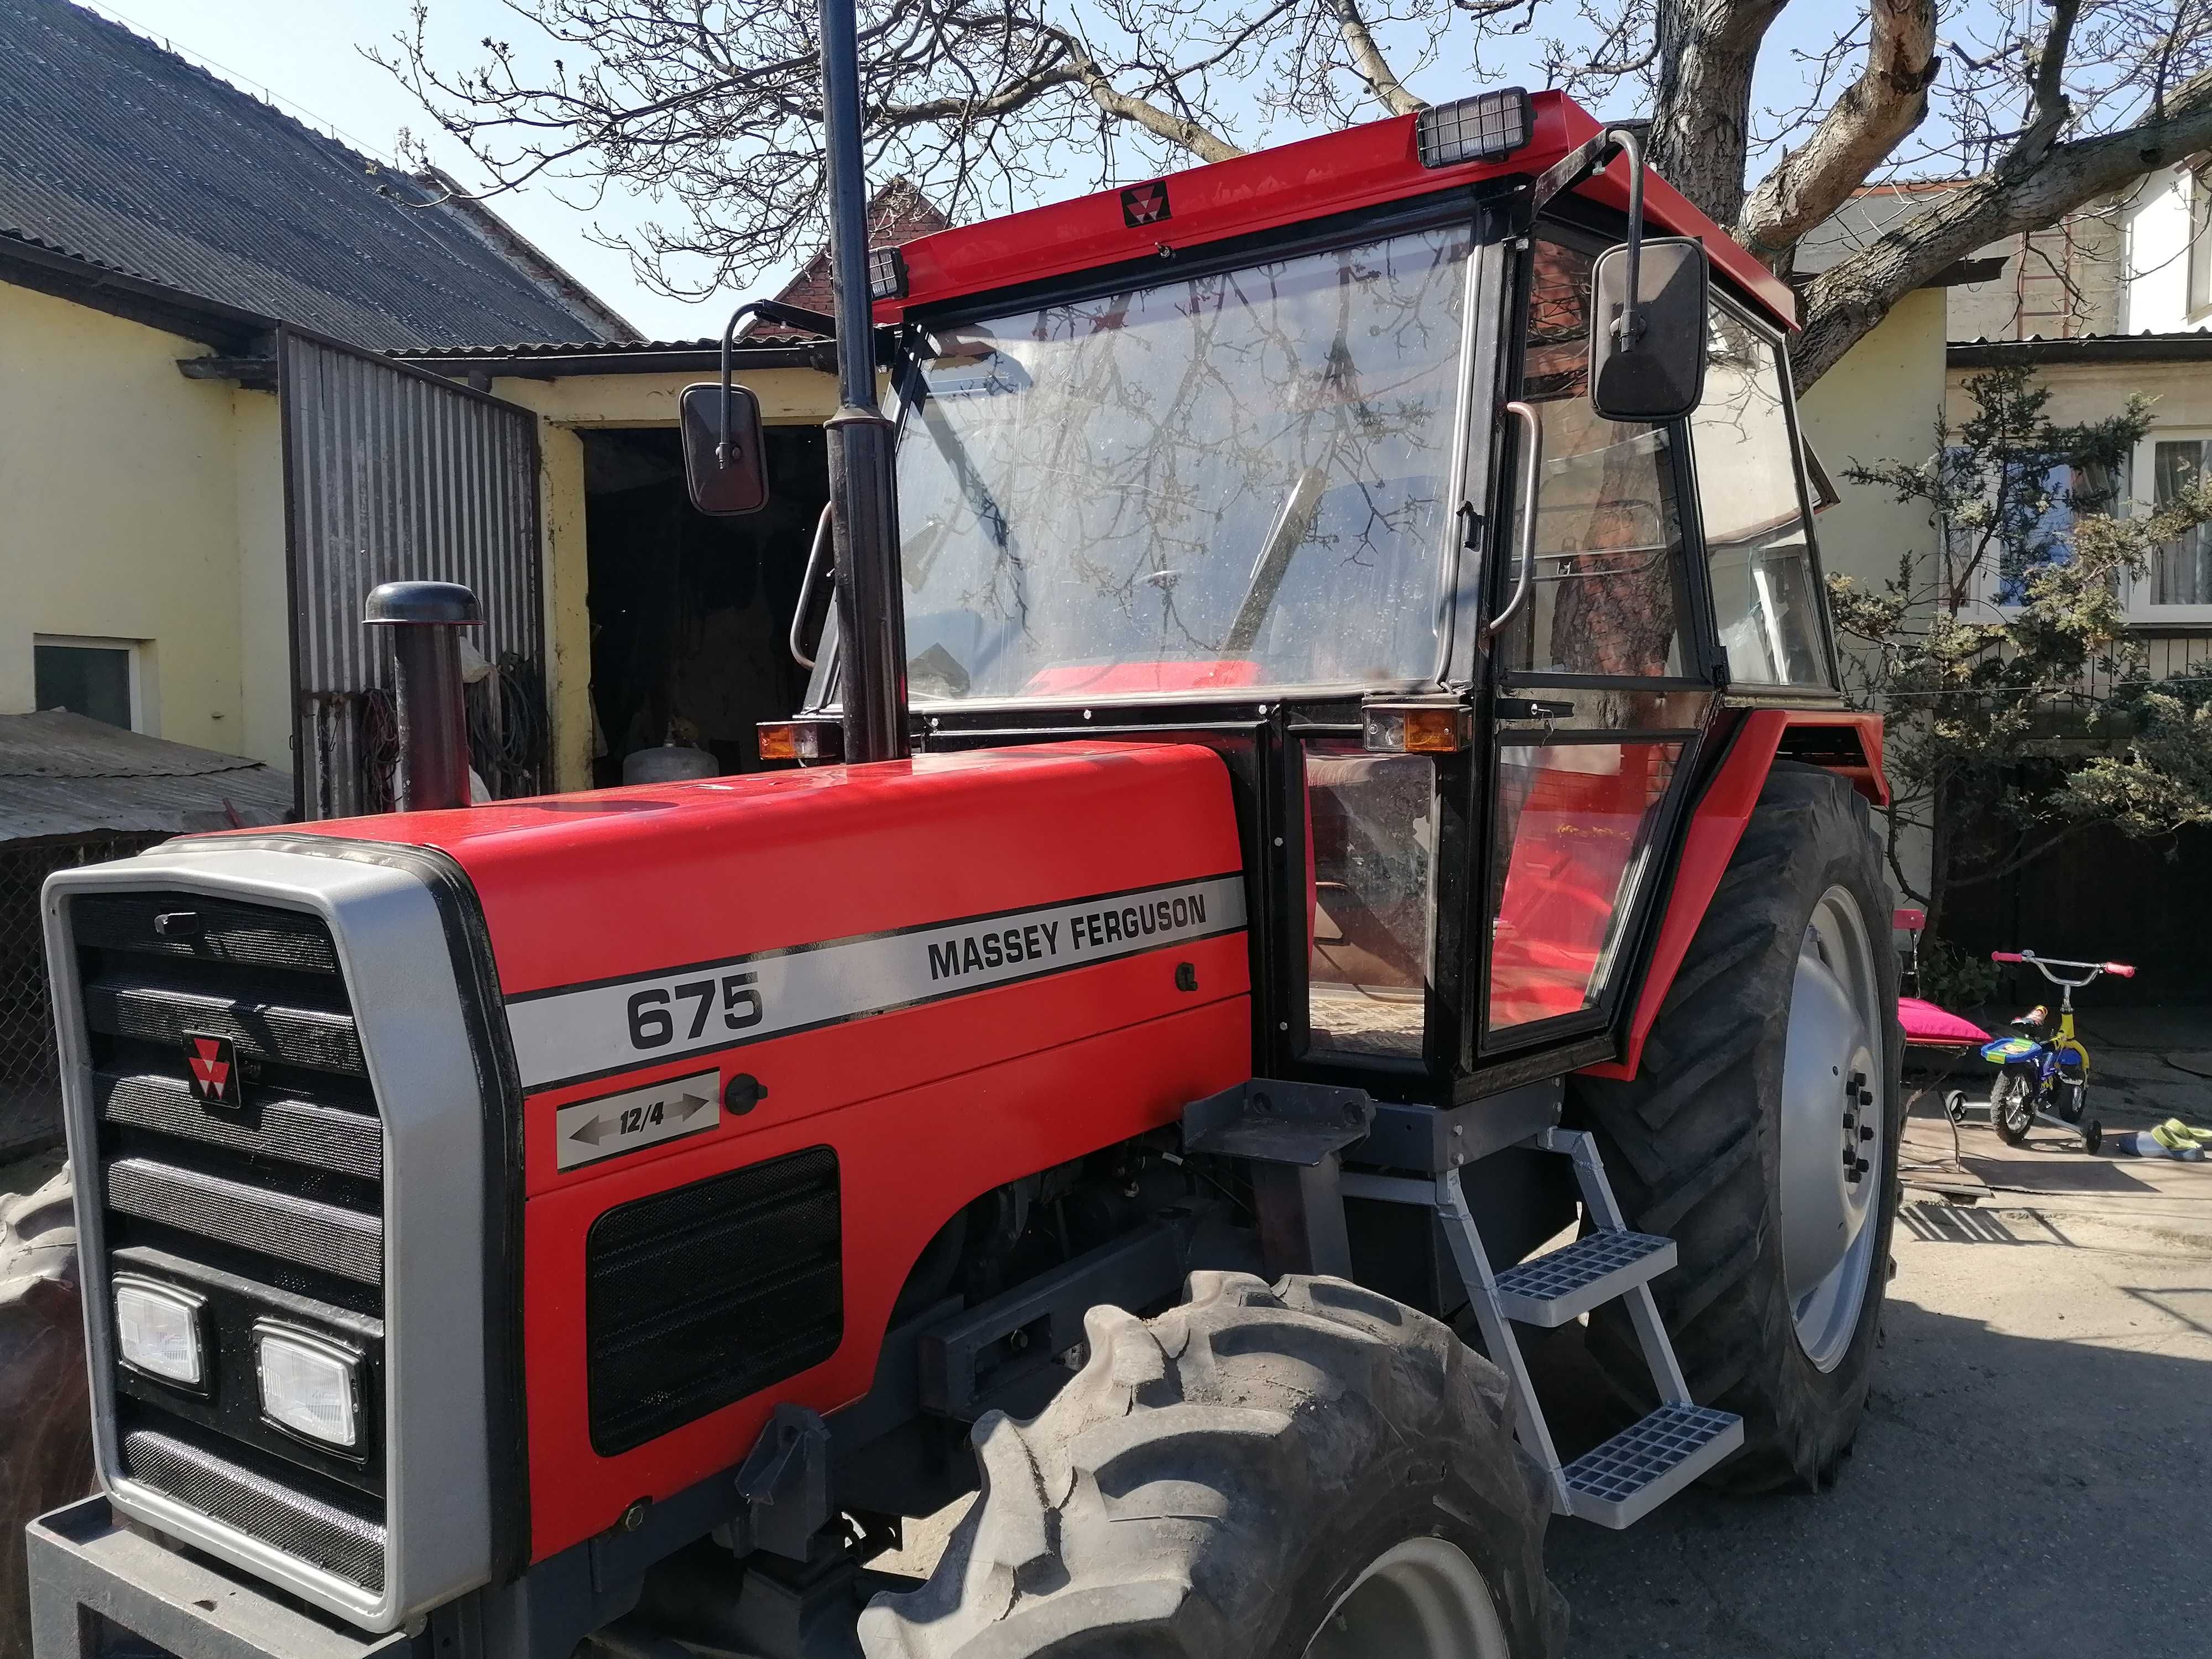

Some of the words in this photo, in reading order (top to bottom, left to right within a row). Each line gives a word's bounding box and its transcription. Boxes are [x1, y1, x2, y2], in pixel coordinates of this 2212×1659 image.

[927, 921, 1058, 979] MASSEY
[1070, 894, 1206, 950] FERGUSON
[627, 972, 763, 1050] 675
[620, 1101, 664, 1135] 12/4
